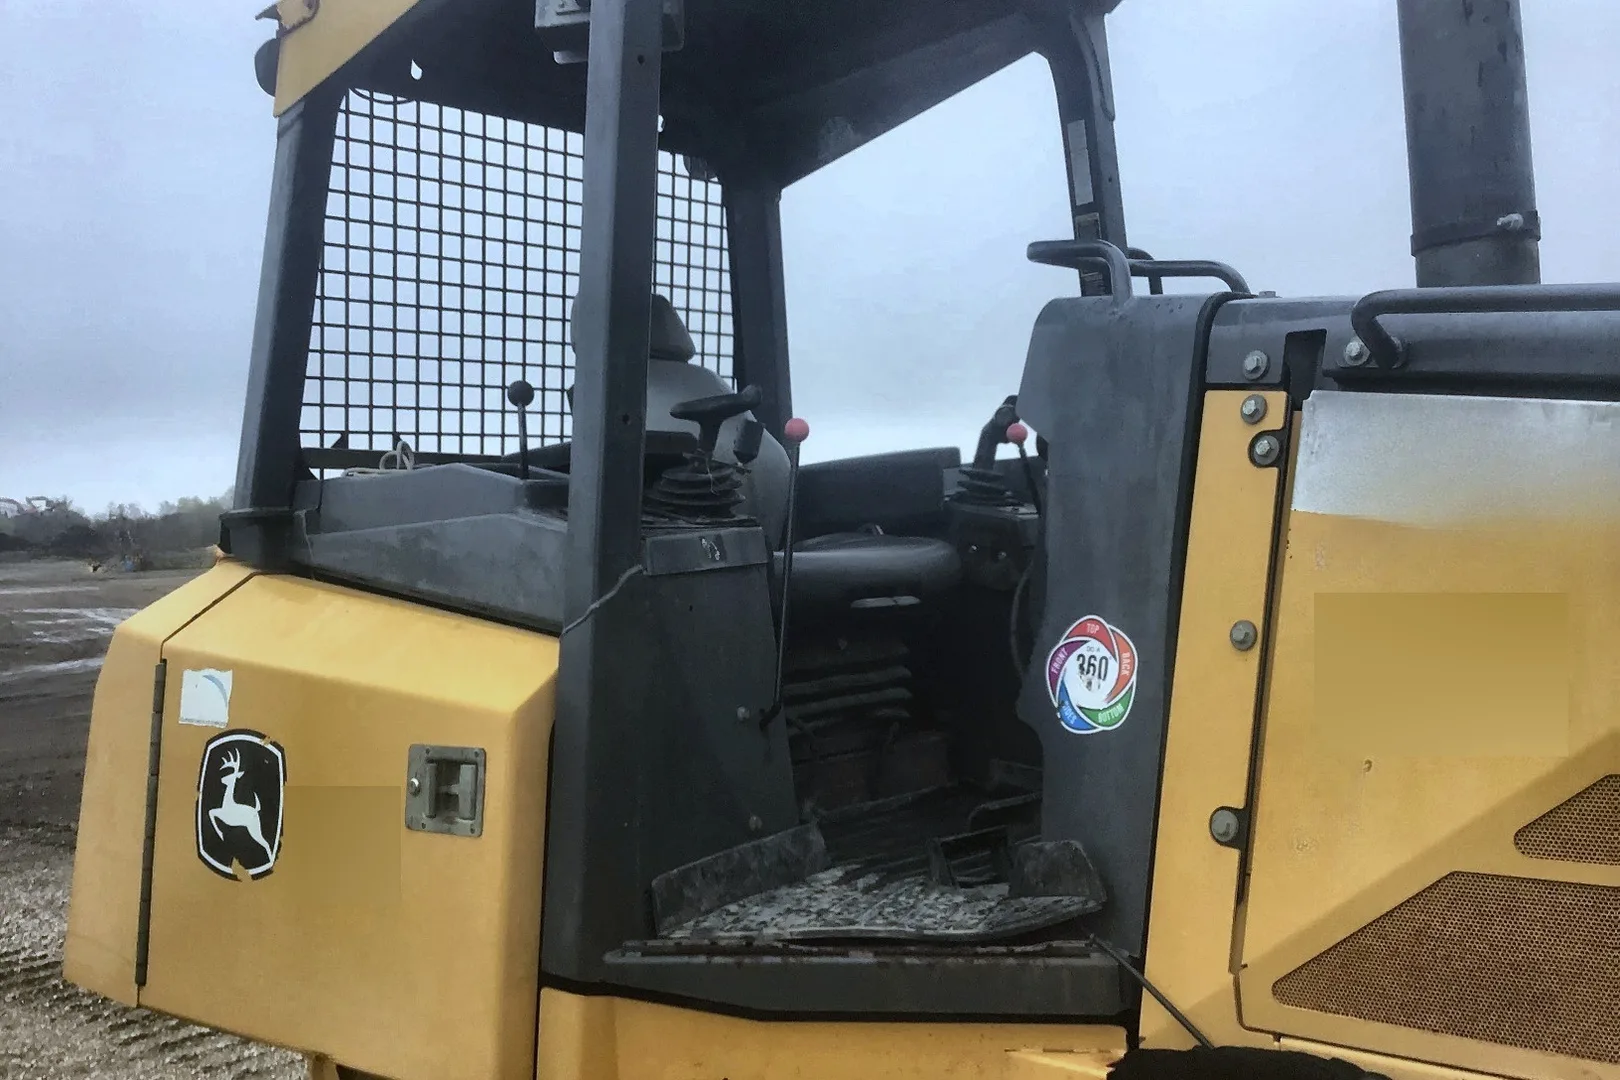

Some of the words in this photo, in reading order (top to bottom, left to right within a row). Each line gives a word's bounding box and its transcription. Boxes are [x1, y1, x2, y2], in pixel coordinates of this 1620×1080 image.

[1086, 623, 1100, 633] TOP
[1051, 647, 1069, 674] FRONT
[1076, 653, 1108, 681] 360
[1122, 652, 1131, 676] BACK
[1098, 703, 1124, 723] BOTTOM
